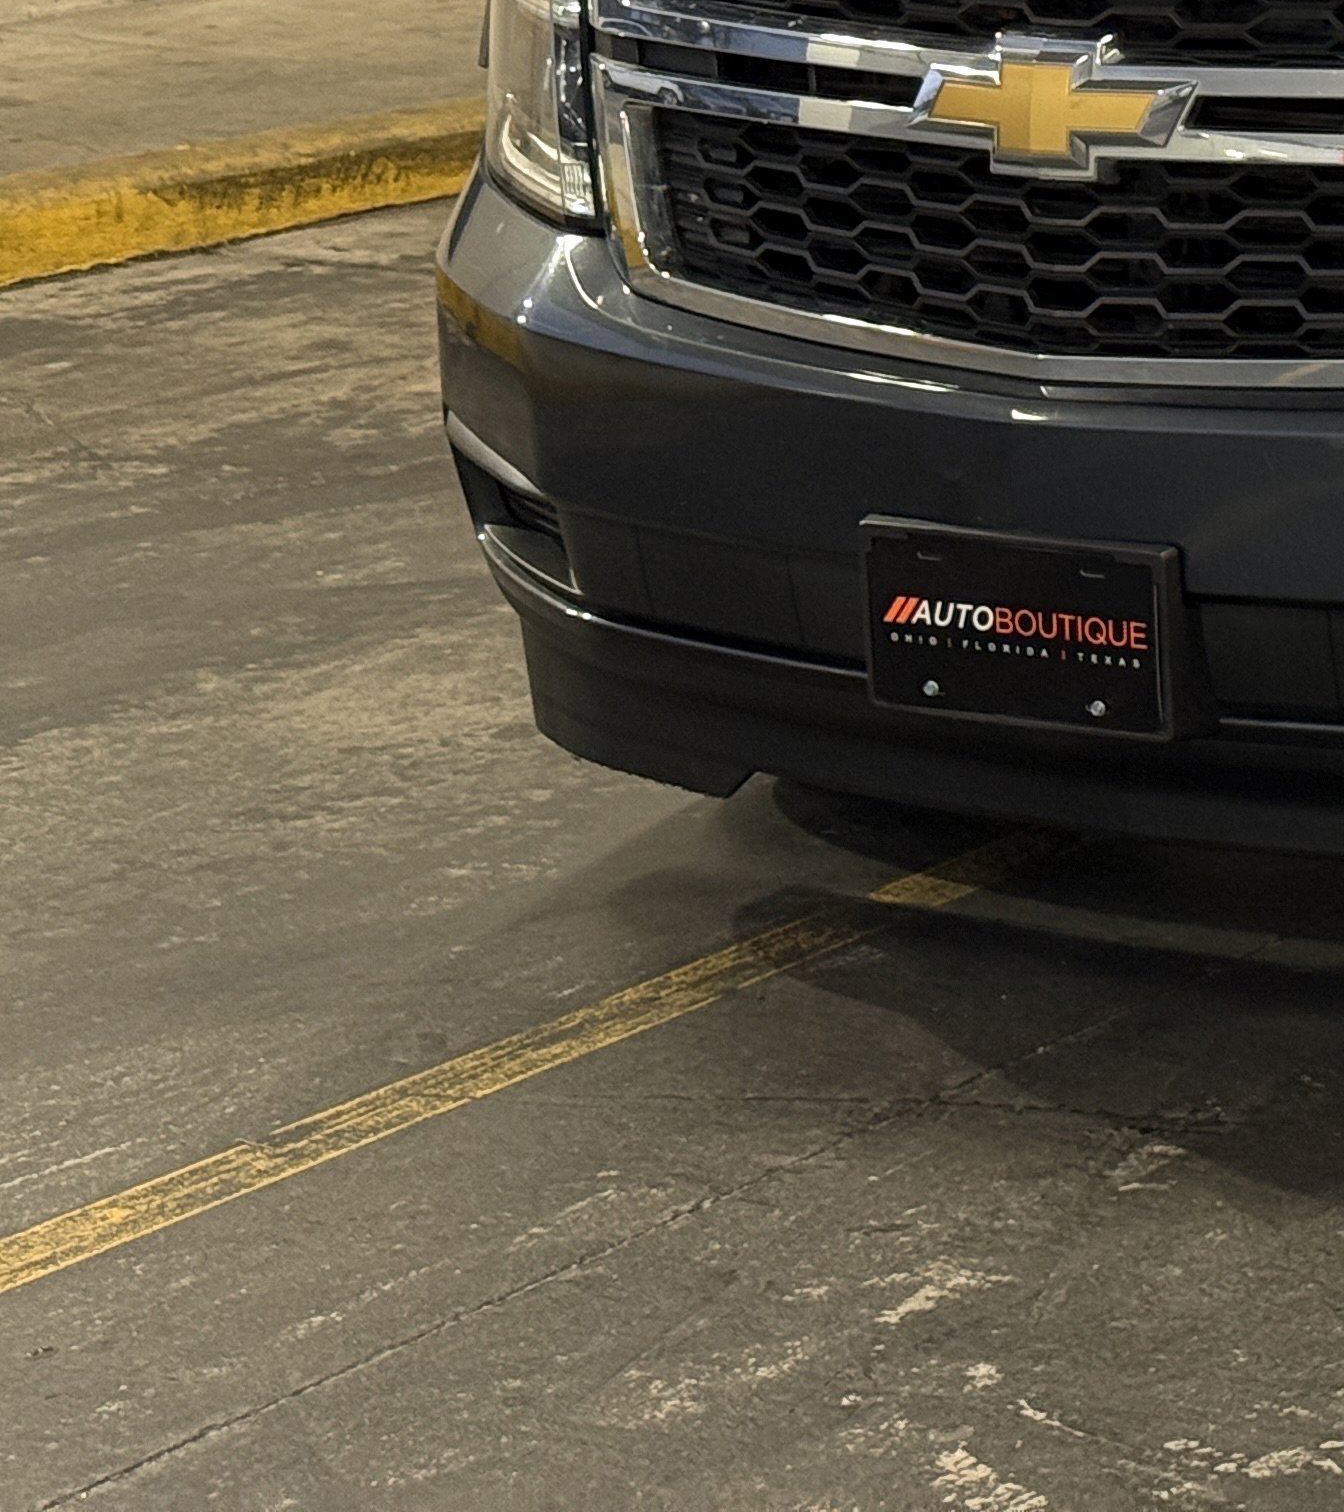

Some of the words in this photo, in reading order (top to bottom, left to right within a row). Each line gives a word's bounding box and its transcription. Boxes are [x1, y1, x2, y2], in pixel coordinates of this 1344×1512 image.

[890, 631, 938, 647] OHIO
[962, 639, 1049, 659] FLORIDA
[1077, 652, 1141, 669] TEXAS
